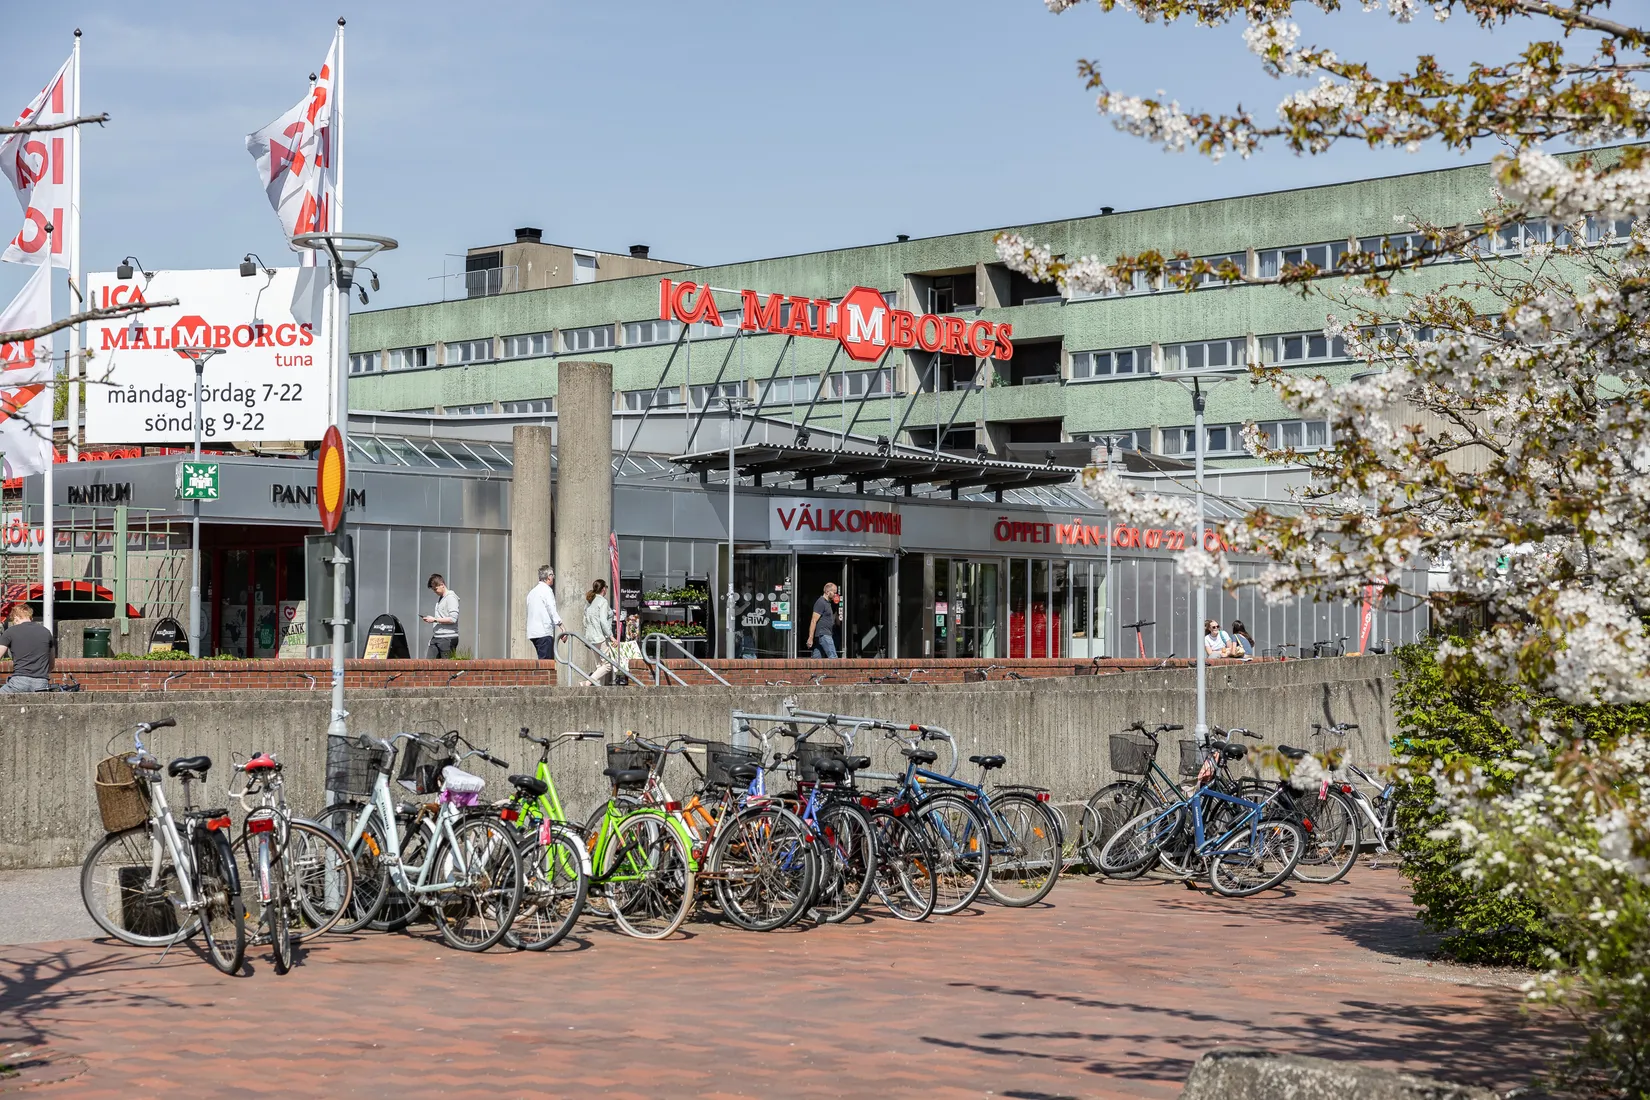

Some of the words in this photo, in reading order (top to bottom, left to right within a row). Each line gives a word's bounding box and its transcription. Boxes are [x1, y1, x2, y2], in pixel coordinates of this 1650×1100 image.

[102, 285, 151, 311] ICA
[659, 278, 724, 327] ICA
[101, 322, 313, 351] MALMBORGS
[741, 288, 1014, 361] MALMBORGS
[275, 352, 313, 366] tuna
[262, 383, 303, 402] 7-22
[223, 412, 264, 431] 9-22
[68, 482, 131, 503] PANTRUM
[270, 484, 366, 507] PANTM
[777, 502, 902, 536] VÄLKOMMEN
[994, 516, 1054, 544] ÖPPET
